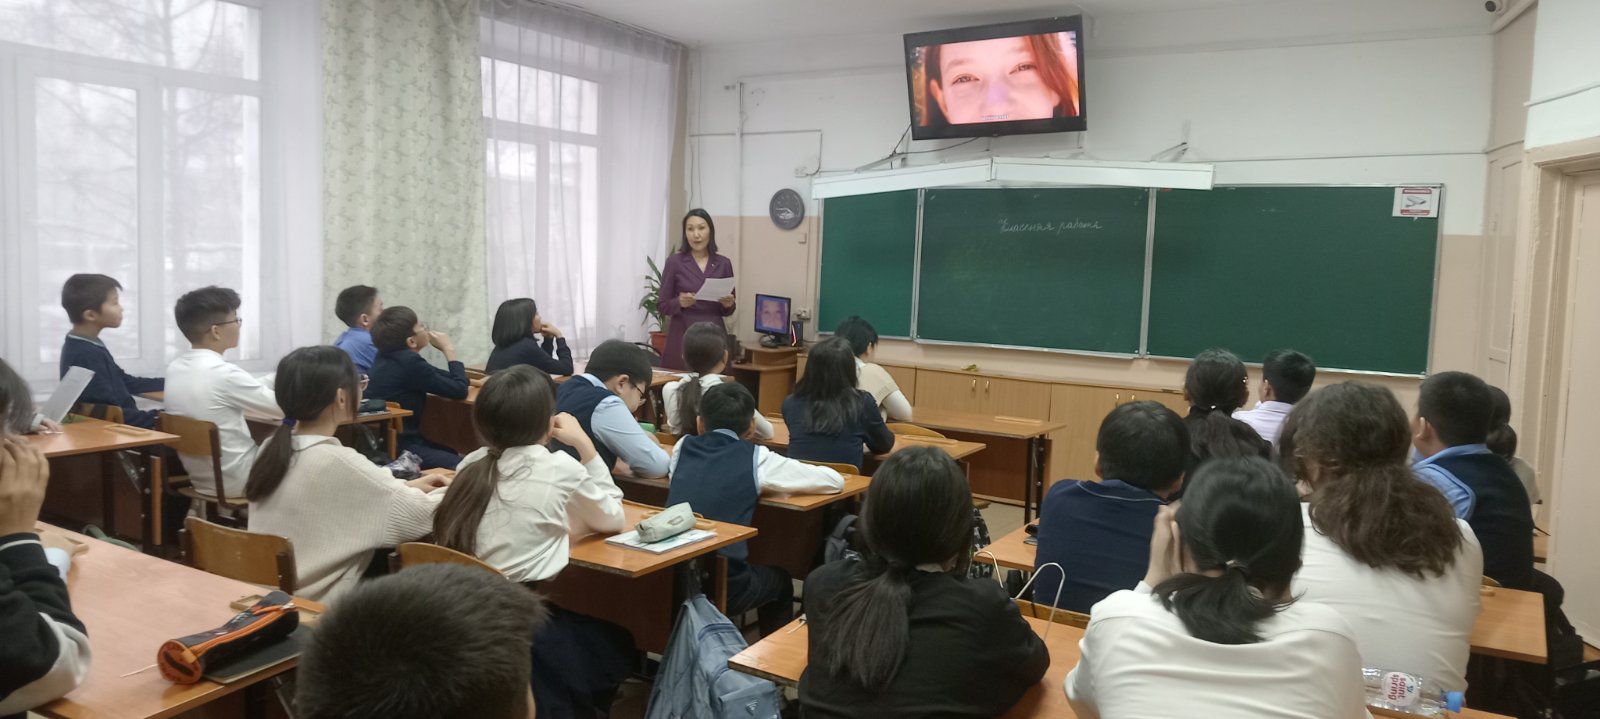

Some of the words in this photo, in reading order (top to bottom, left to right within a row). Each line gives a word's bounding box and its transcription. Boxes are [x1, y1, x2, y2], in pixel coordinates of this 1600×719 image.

[1056, 216, 1103, 236] работа
[1388, 674, 1400, 700] spring
[1398, 677, 1406, 698] saint
